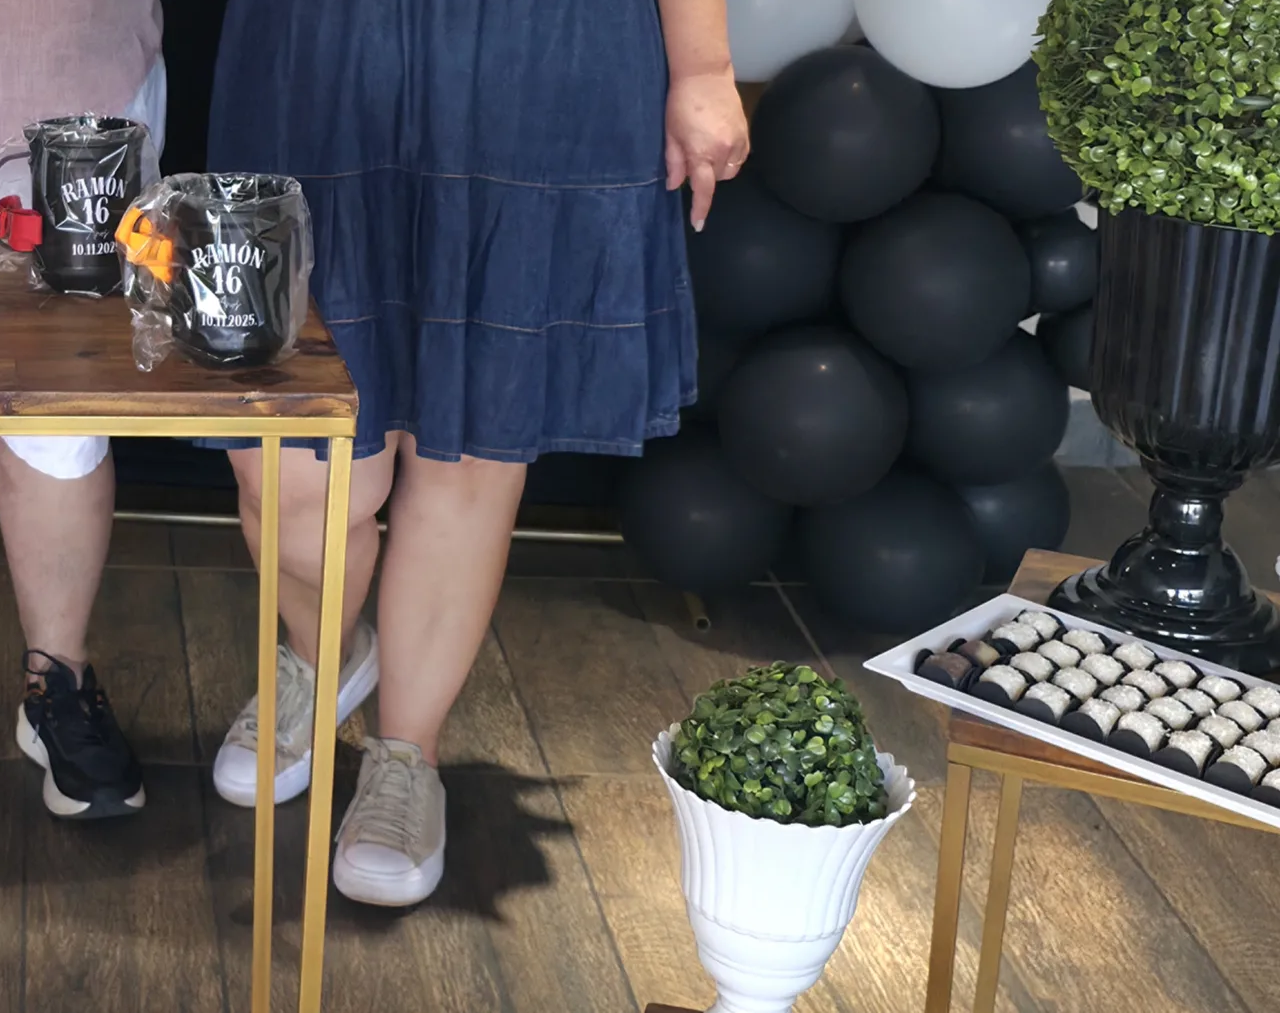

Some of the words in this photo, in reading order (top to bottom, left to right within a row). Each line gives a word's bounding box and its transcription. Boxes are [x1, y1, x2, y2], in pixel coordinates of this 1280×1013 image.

[82, 196, 110, 225] 16
[71, 241, 119, 256] 10.11.202
[191, 240, 266, 269] RAMÓN
[212, 265, 243, 295] 16
